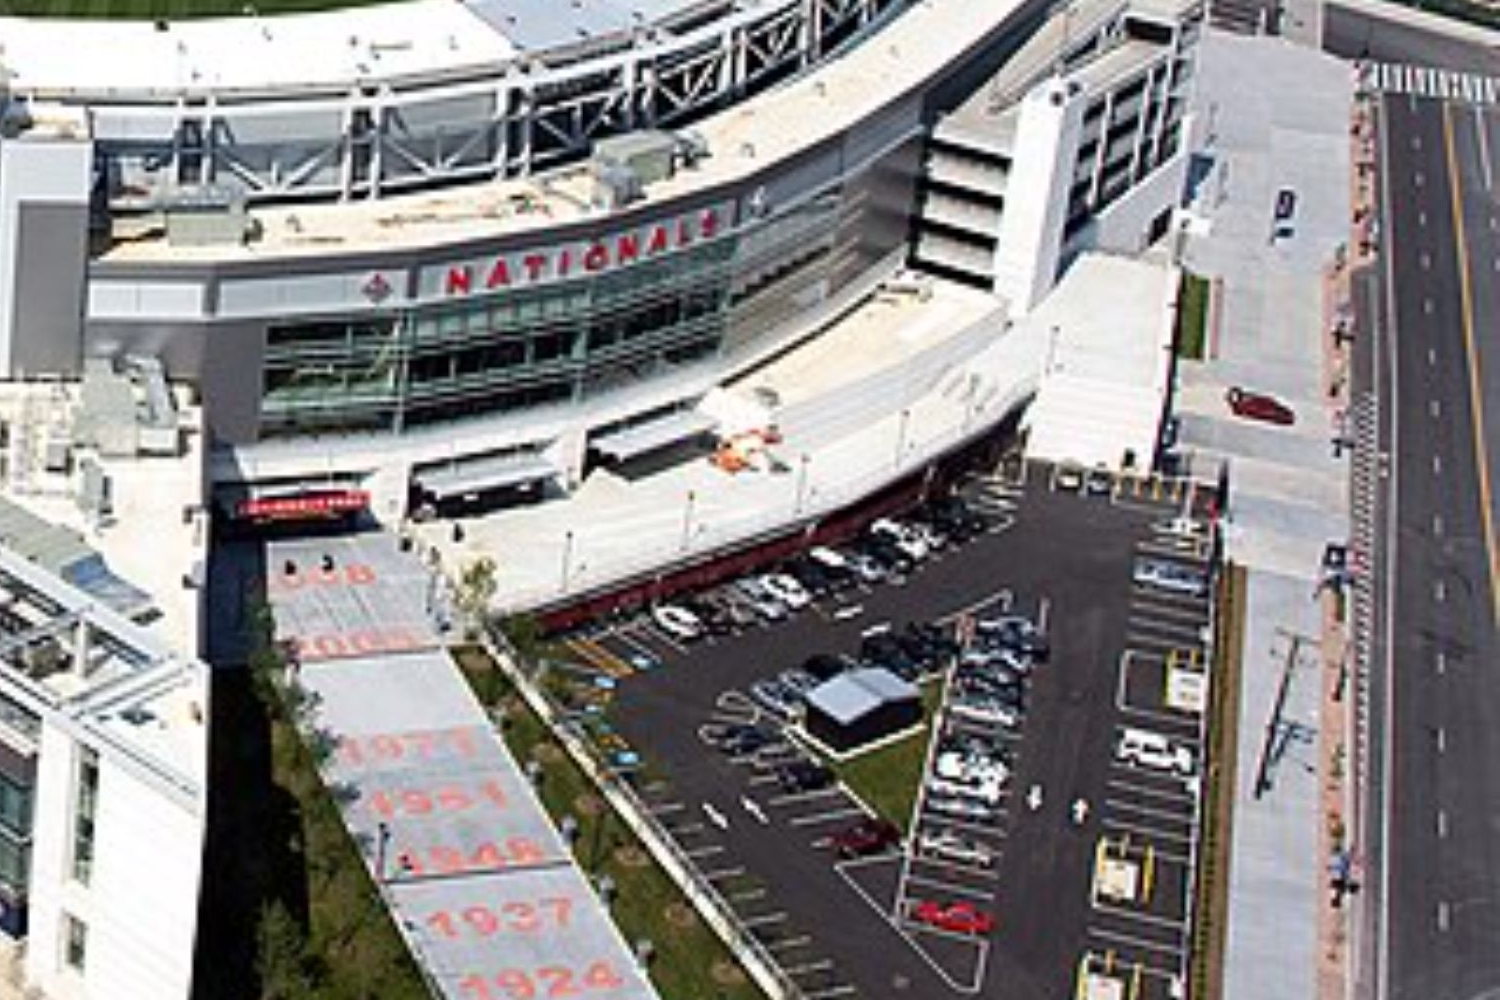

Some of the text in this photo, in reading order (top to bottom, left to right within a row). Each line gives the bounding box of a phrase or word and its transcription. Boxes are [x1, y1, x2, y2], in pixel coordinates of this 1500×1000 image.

[445, 209, 717, 296] NATIONALS
[425, 895, 574, 940] 1937
[458, 958, 625, 1000] 1924
